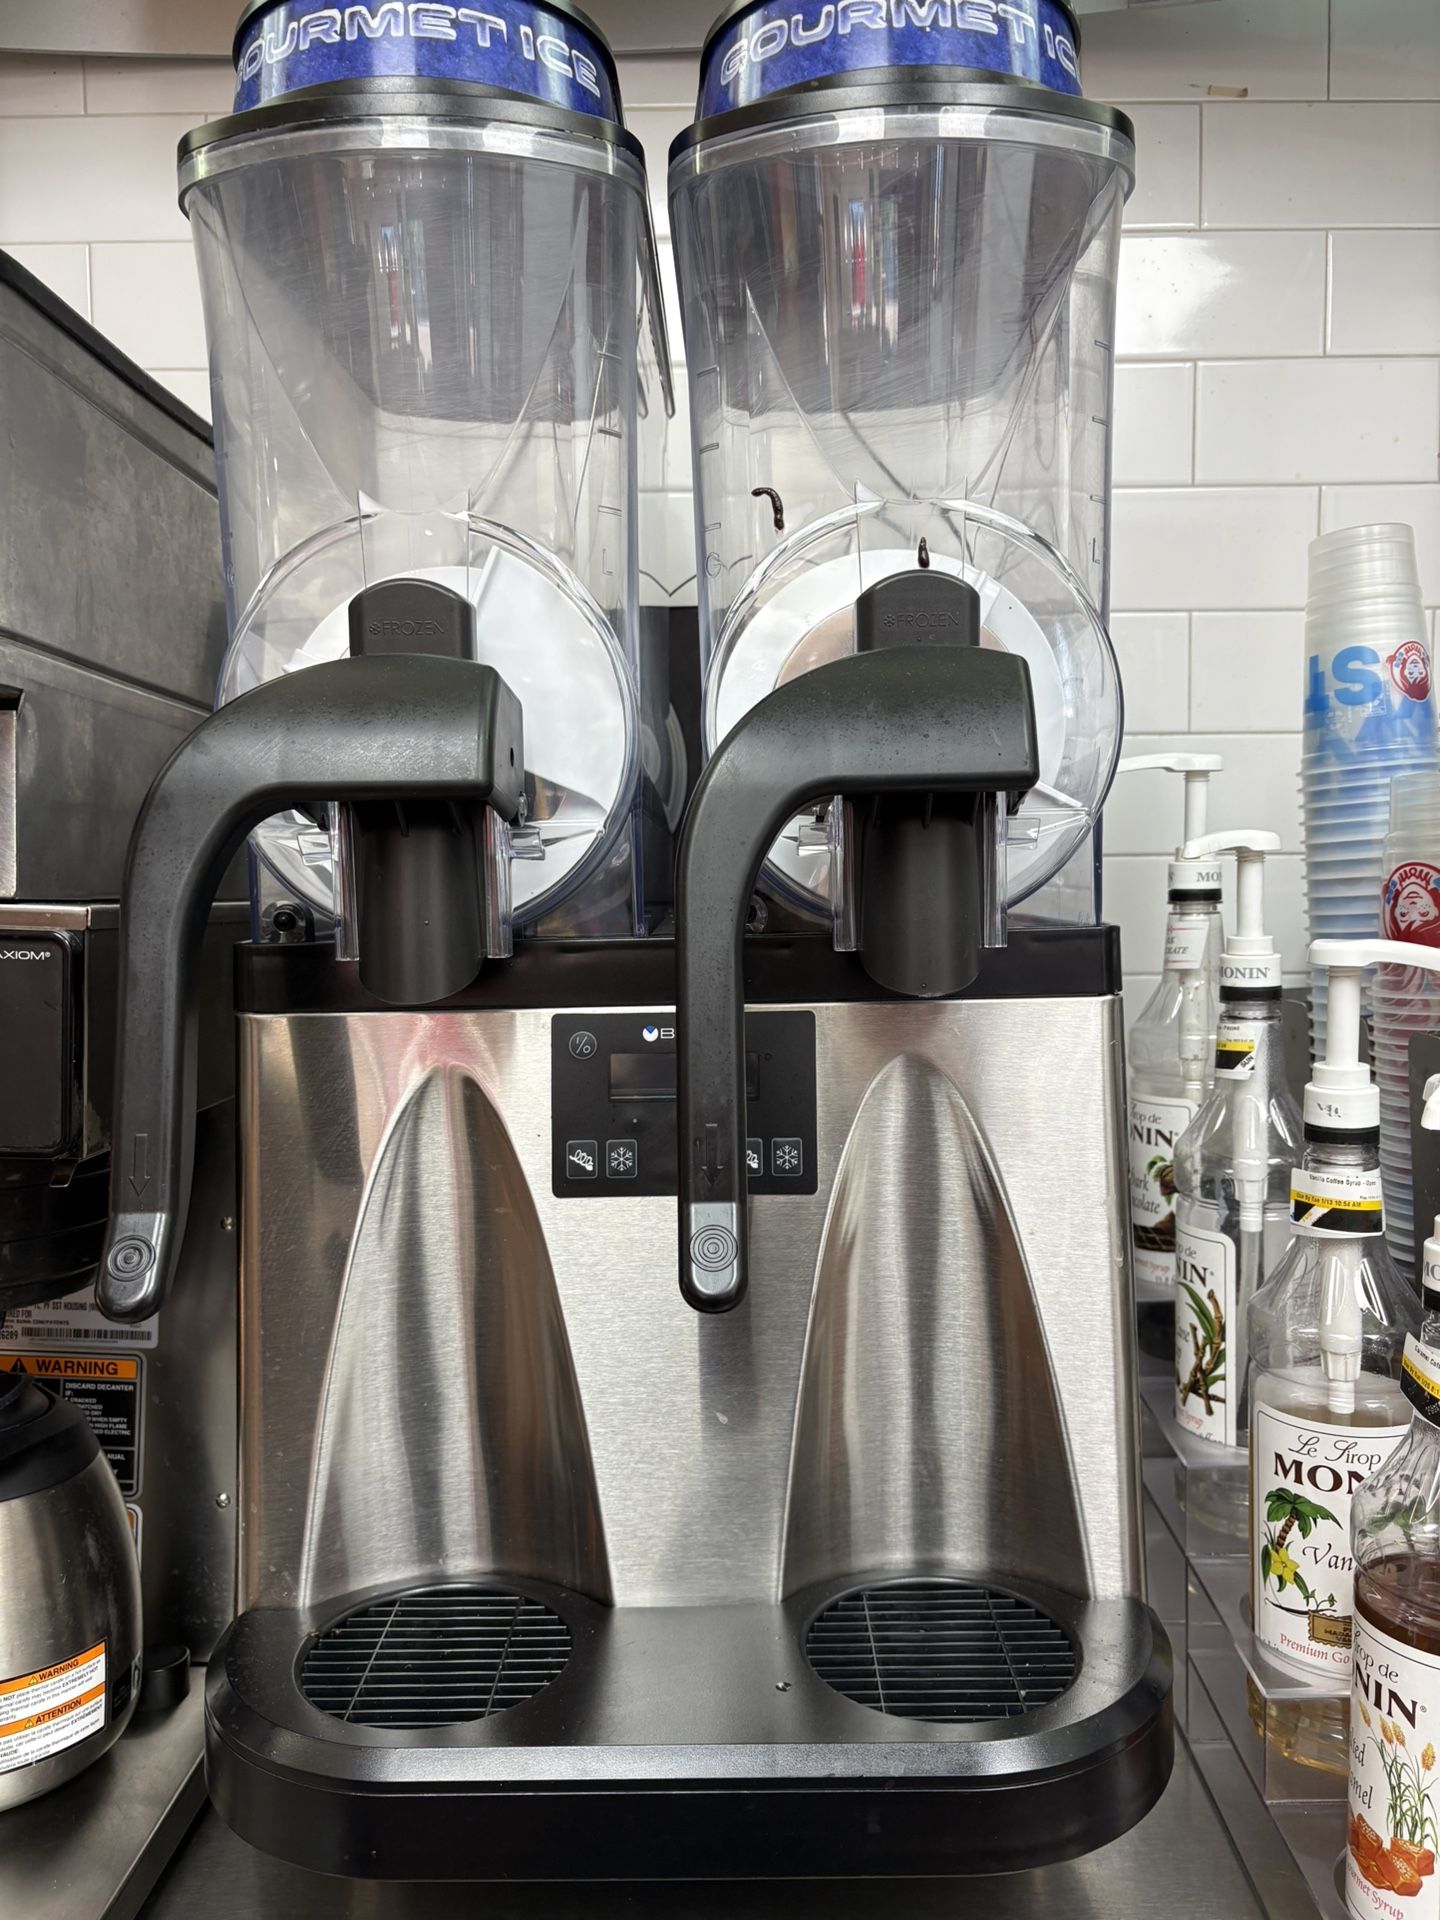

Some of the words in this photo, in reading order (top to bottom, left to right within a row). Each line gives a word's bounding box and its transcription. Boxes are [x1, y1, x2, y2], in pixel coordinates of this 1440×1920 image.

[720, 0, 1036, 86] GOURMET
[1044, 24, 1078, 79] IC
[520, 25, 601, 99] ICE
[383, 620, 445, 636] FROZEN
[897, 611, 960, 628] FROZEN
[1220, 966, 1267, 979] ONIN
[1148, 1113, 1162, 1125] de
[1326, 1177, 1344, 1185] Coffee
[36, 1359, 118, 1375] WARNING
[65, 1382, 96, 1390] DISCARD
[97, 1383, 134, 1391] DECANTER
[1288, 1434, 1320, 1458] Le
[1324, 1440, 1382, 1471] Sirop
[1302, 1543, 1353, 1571] Van
[1280, 1633, 1328, 1661] Premium
[1331, 1651, 1350, 1664] Go
[38, 1659, 79, 1680] WARNING
[1378, 1663, 1399, 1684] de
[35, 1698, 82, 1724] ATTENTION
[1372, 1890, 1404, 1920] Syrup
